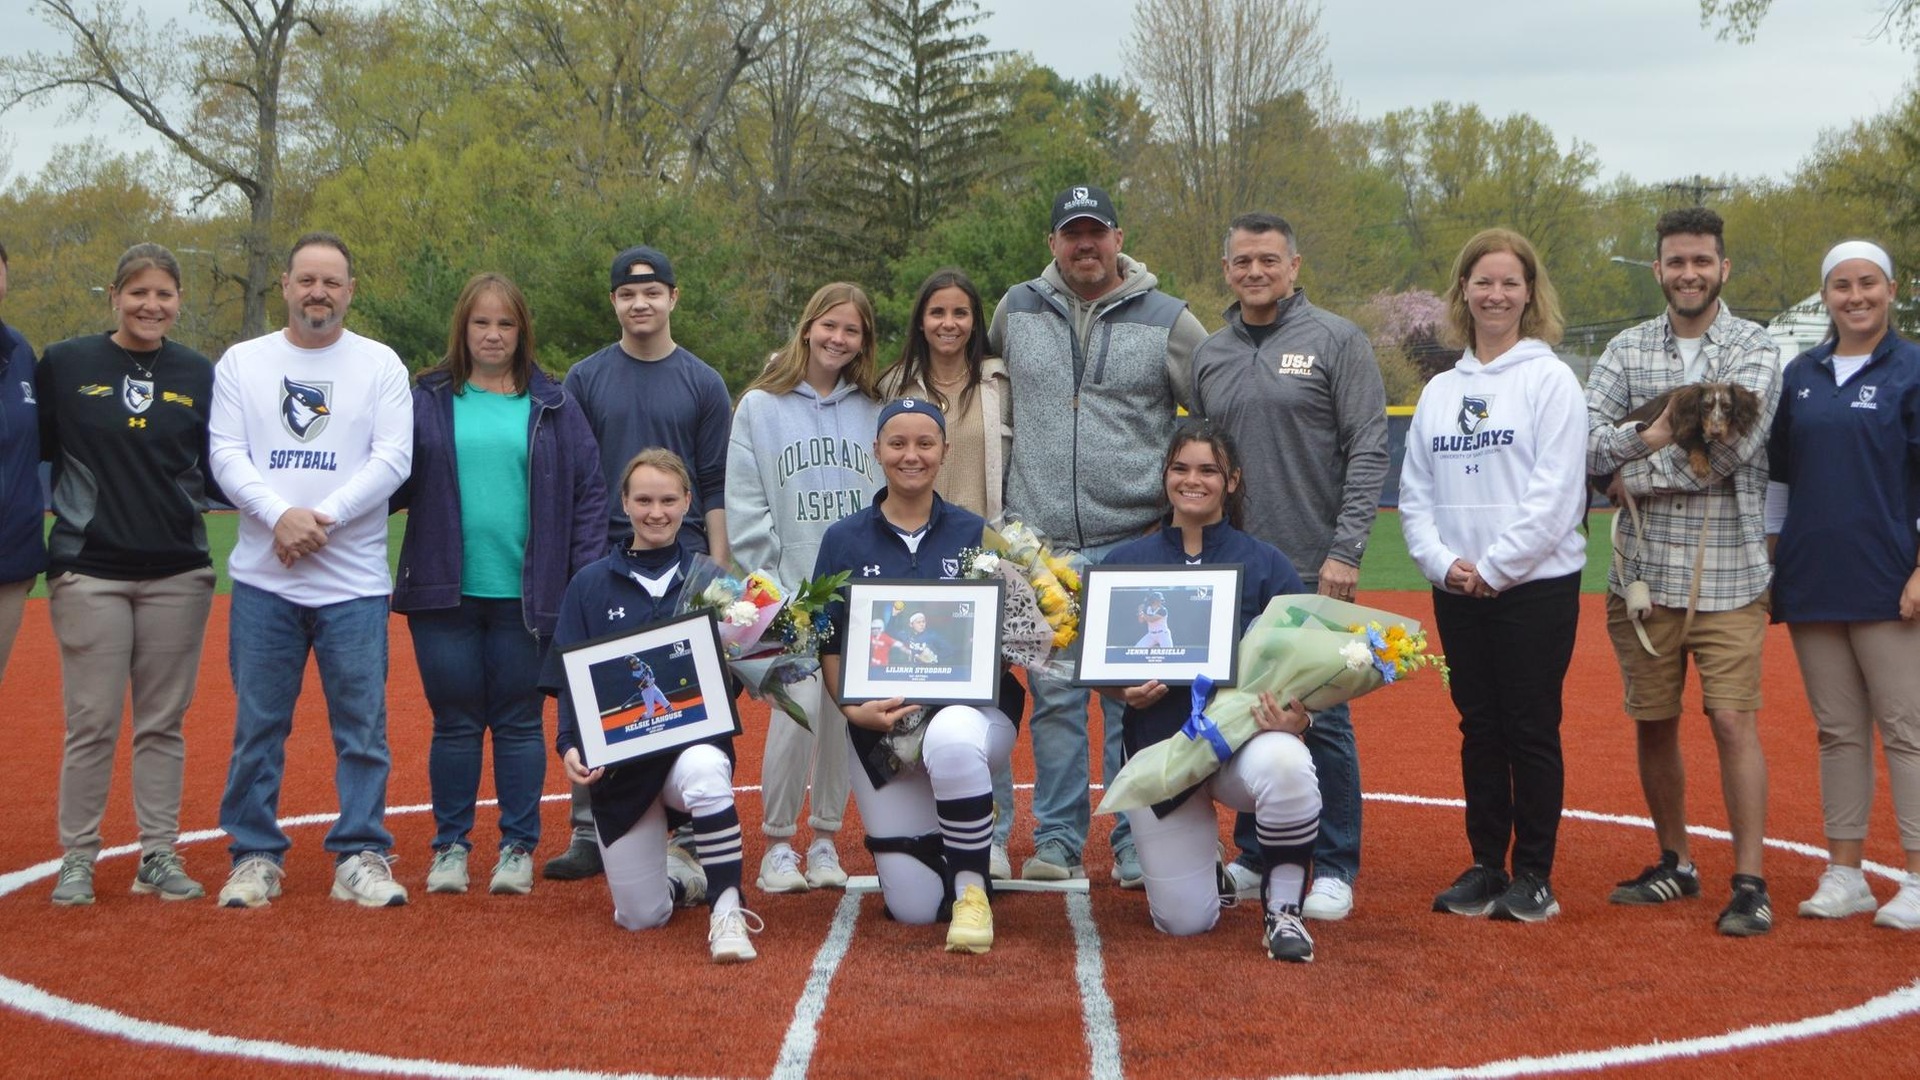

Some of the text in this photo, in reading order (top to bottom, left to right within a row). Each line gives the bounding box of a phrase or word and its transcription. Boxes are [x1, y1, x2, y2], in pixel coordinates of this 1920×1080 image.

[1281, 354, 1315, 369] USJ
[1433, 430, 1515, 452] BLUEJAYS
[269, 449, 338, 471] SOFTBALL
[797, 489, 862, 520] ASPEN
[1125, 648, 1149, 656] JENNA
